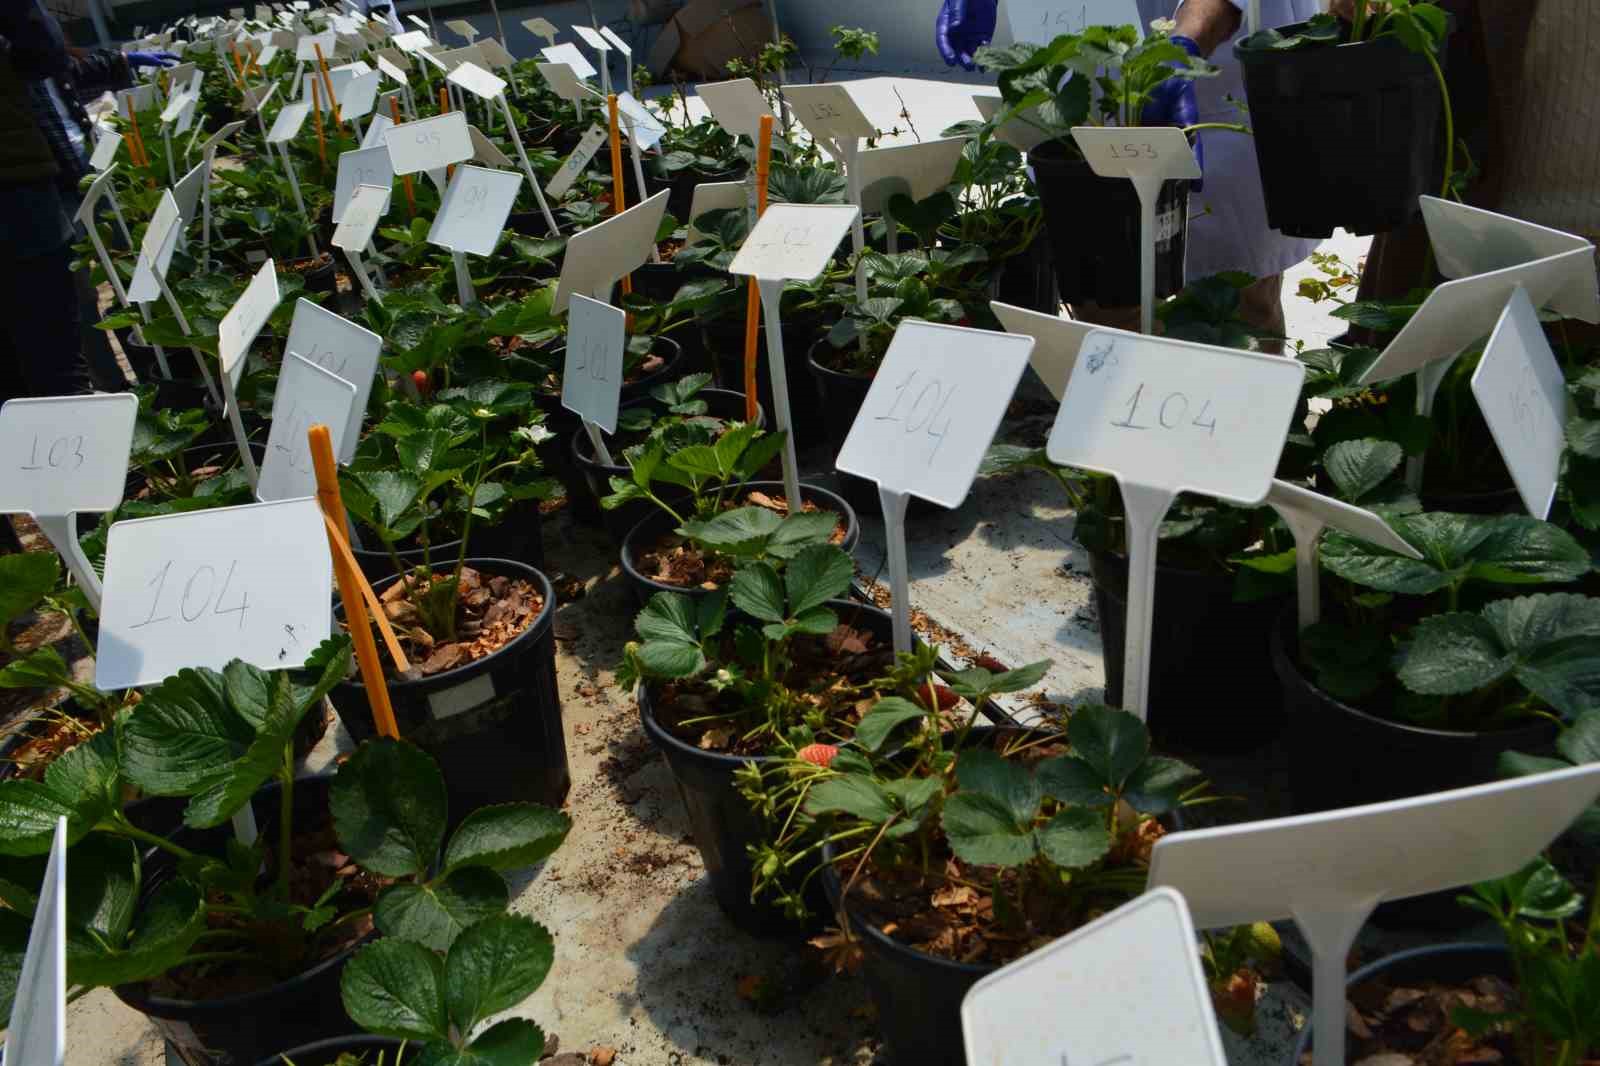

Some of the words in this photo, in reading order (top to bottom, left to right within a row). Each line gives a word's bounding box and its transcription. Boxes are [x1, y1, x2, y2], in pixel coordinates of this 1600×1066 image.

[1109, 143, 1159, 160] 153
[874, 369, 959, 466] 104
[1109, 383, 1217, 437] 104
[19, 431, 86, 470] 103
[128, 559, 251, 630] 104
